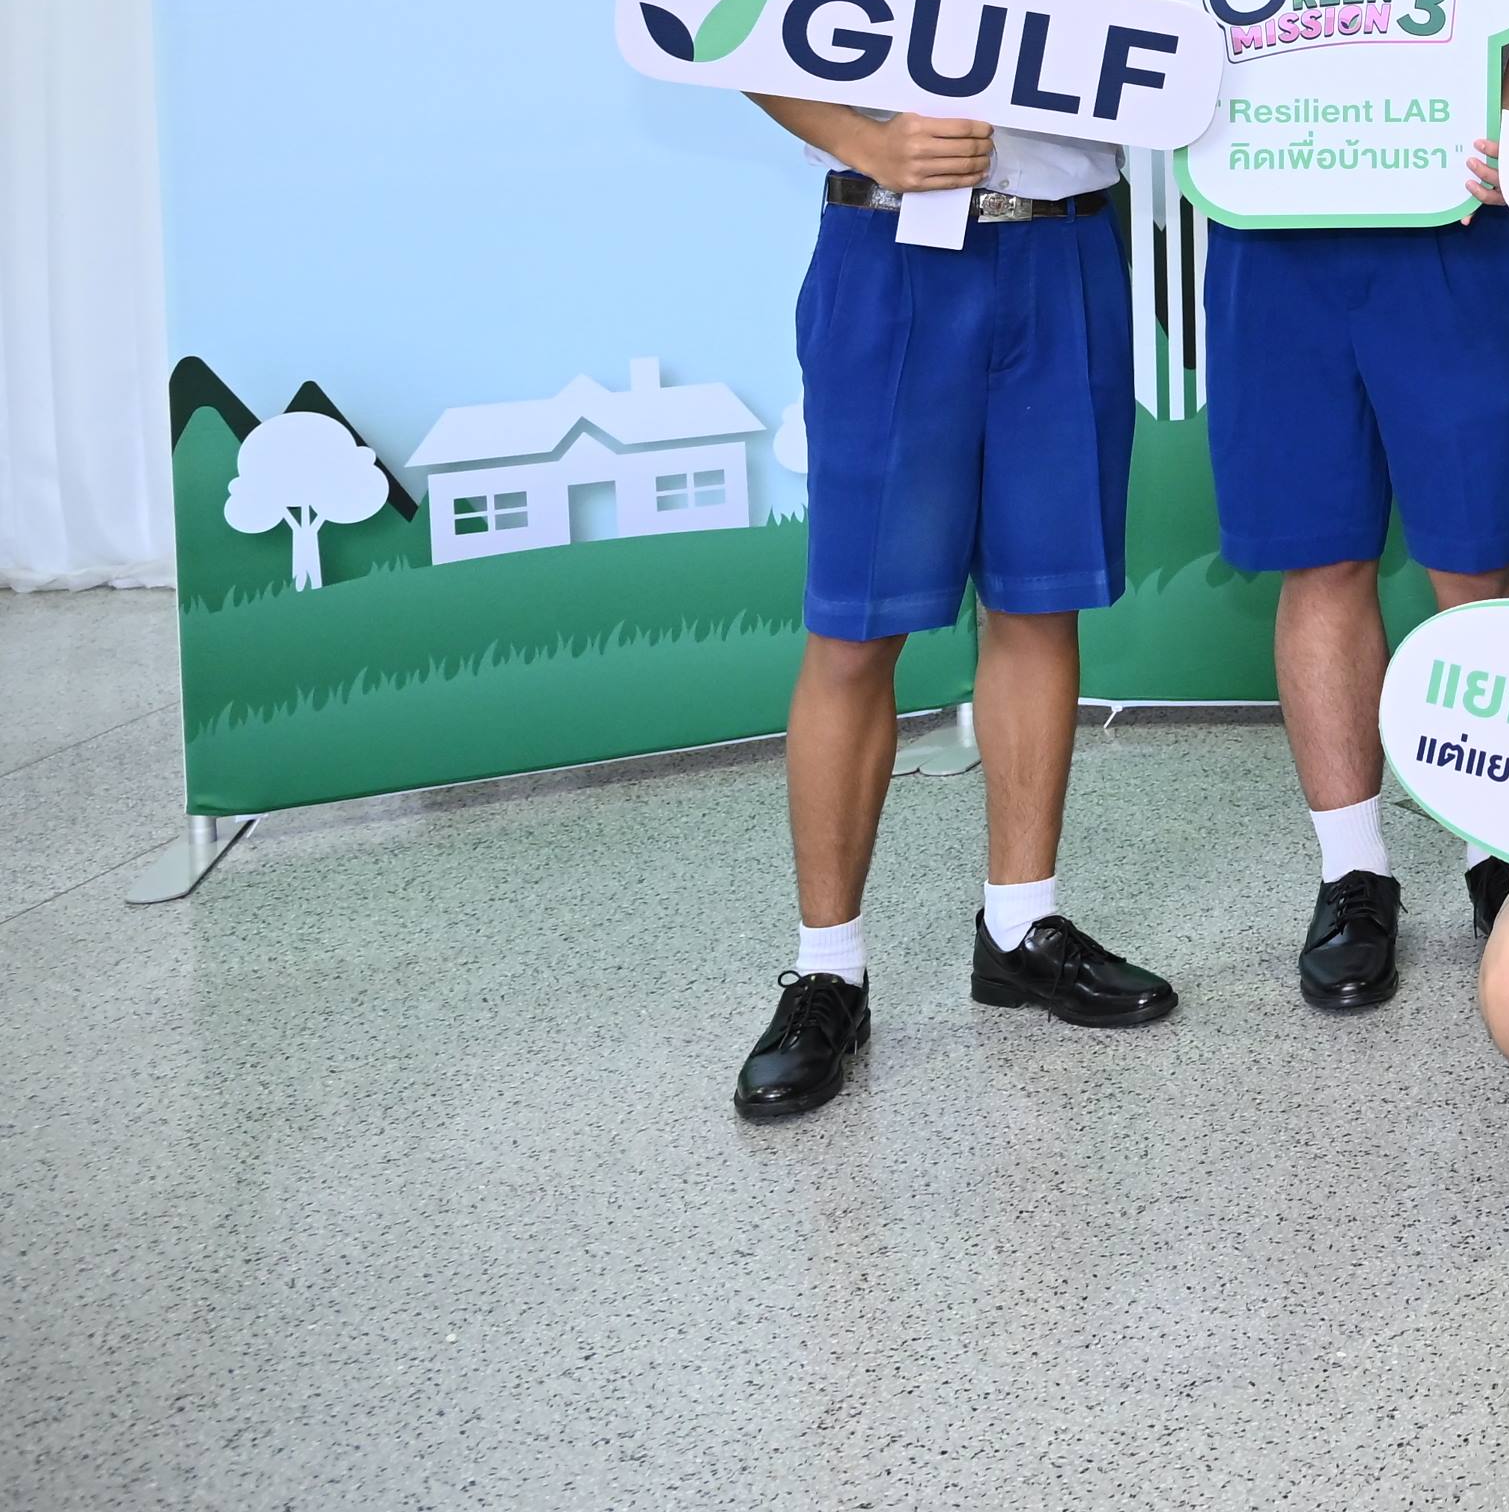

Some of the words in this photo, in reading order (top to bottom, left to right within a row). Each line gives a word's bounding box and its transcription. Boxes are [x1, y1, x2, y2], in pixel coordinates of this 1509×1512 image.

[1229, 3, 1392, 56] MISSION
[1229, 98, 1374, 124] Resilient
[1384, 98, 1451, 123] LAB
[1229, 130, 1448, 170] คิดเพื่อบ้านเรา
